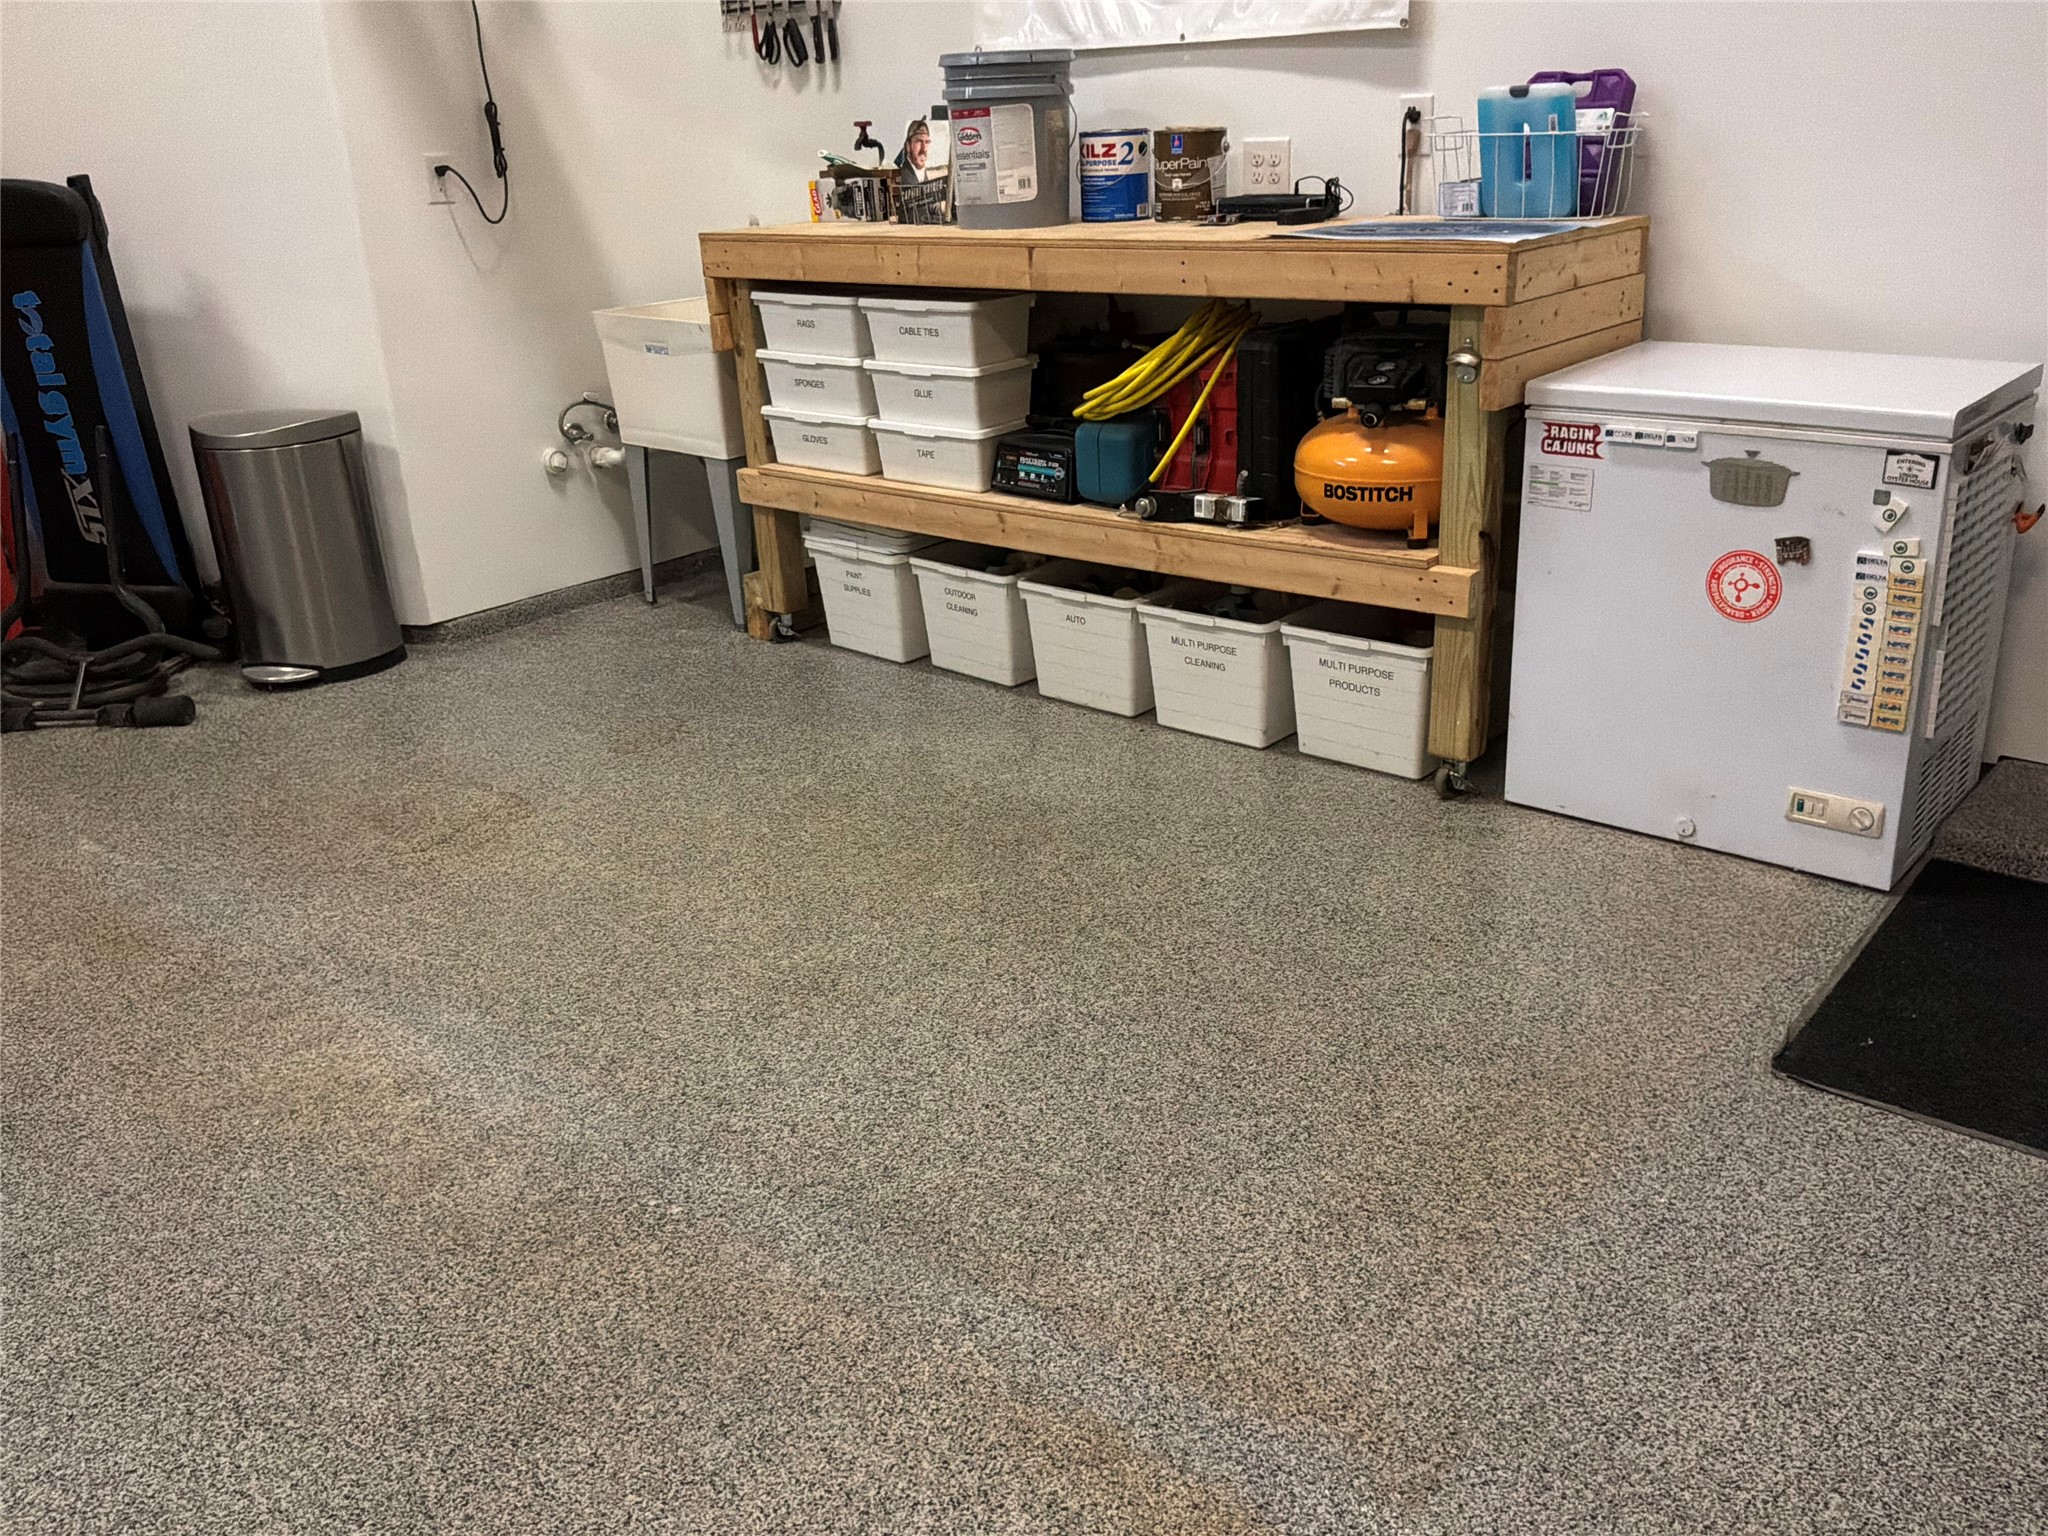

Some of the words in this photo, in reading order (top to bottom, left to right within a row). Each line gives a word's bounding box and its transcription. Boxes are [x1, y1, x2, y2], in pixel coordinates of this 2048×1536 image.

[958, 129, 982, 142] Glidden
[1118, 141, 1134, 165] 2
[811, 190, 822, 215] GLAD
[796, 319, 816, 329] RAGS
[899, 326, 922, 336] CABLE
[923, 328, 940, 338] TIES
[794, 379, 825, 389] SPONGES
[914, 389, 933, 399] GLUE
[802, 434, 829, 445] GLOVES
[1550, 425, 1595, 441] RAGIN
[917, 449, 935, 459] TAPE
[1543, 439, 1595, 456] CAJUNS
[1896, 458, 1926, 468] ENTERING
[1886, 475, 1908, 483] OYSTER
[1323, 483, 1413, 502] BOSTITCH
[1716, 554, 1755, 575] ENDURANCE
[1866, 557, 1888, 566] DELTA
[845, 570, 863, 581] PAINT
[1758, 561, 1777, 595] STRENGTH
[843, 583, 871, 597] SUPPLIES
[944, 587, 976, 601] OUTDOOR
[946, 602, 979, 617] CLEANING
[1065, 614, 1087, 625] AUTO
[1170, 636, 1196, 649] MULTI
[1196, 641, 1238, 656] PURPOSE
[1184, 656, 1226, 672] CLEANING
[1319, 657, 1347, 672] MULTI
[1348, 664, 1395, 681] PURPOSE
[1328, 678, 1381, 697] PRODUCTS
